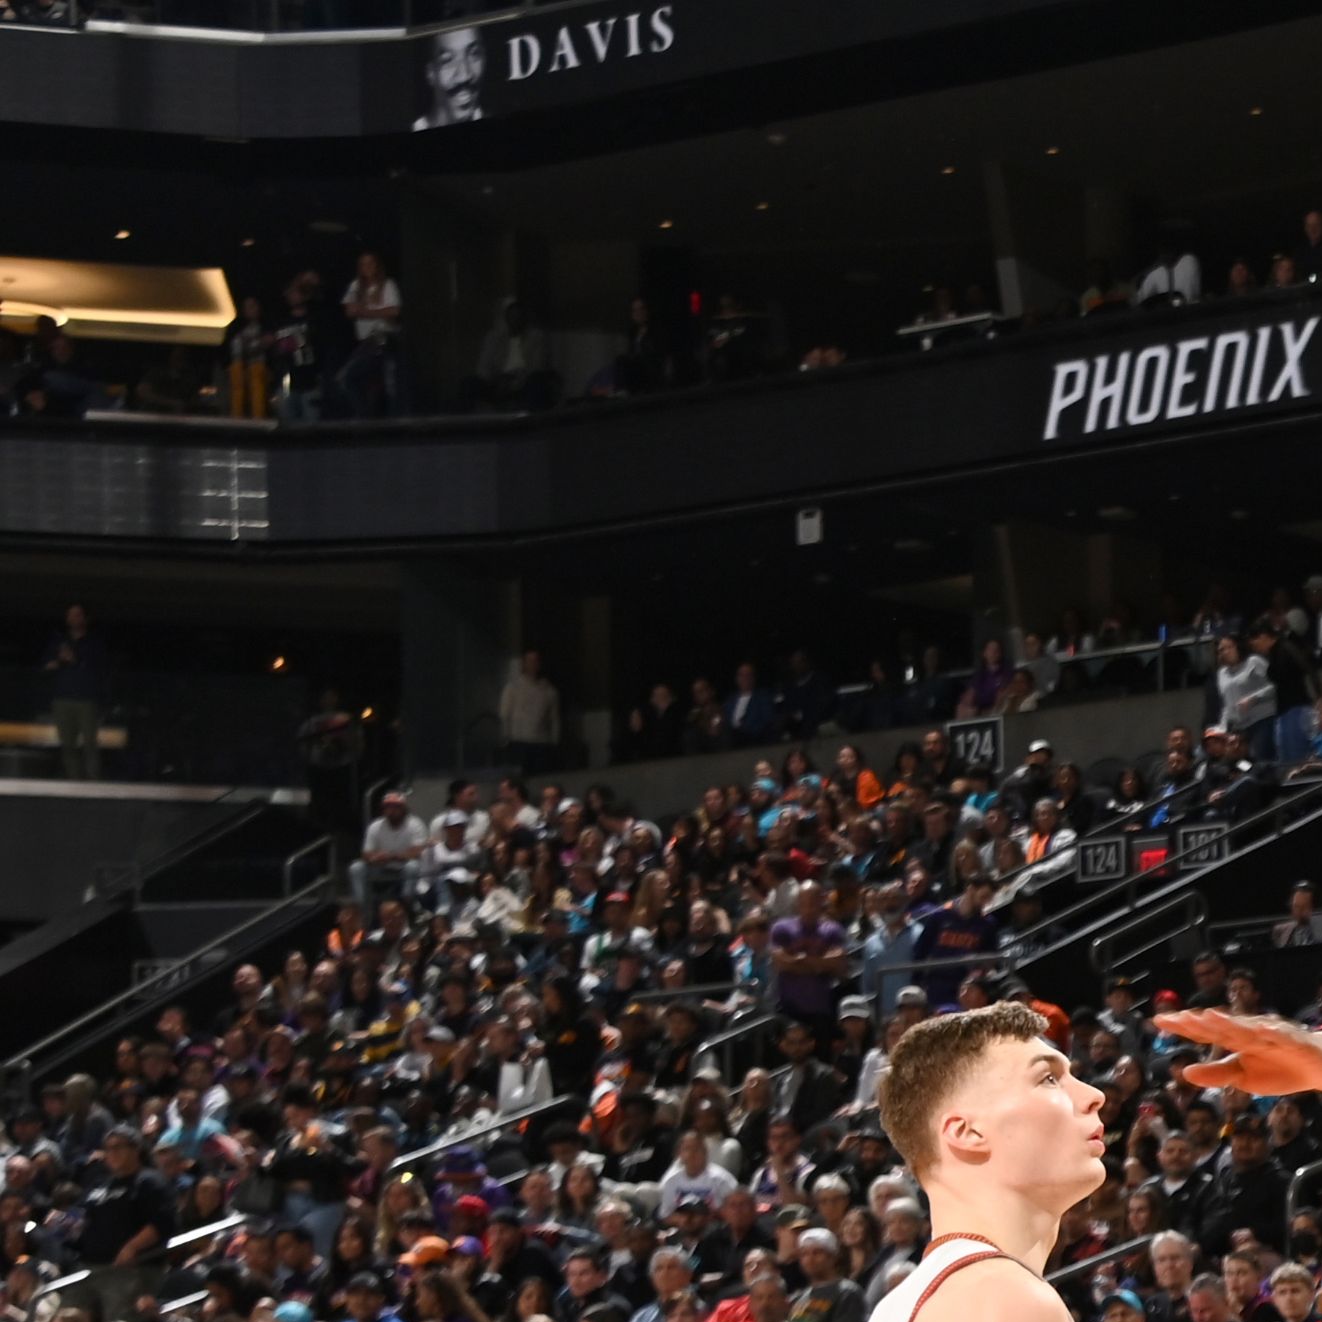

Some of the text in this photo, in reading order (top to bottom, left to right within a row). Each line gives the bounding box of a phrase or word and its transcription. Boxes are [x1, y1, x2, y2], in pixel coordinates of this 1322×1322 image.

[508, 5, 675, 82] DAVIS
[1044, 316, 1320, 440] PHOENIX
[956, 729, 995, 766] 124
[1086, 843, 1118, 875] 124
